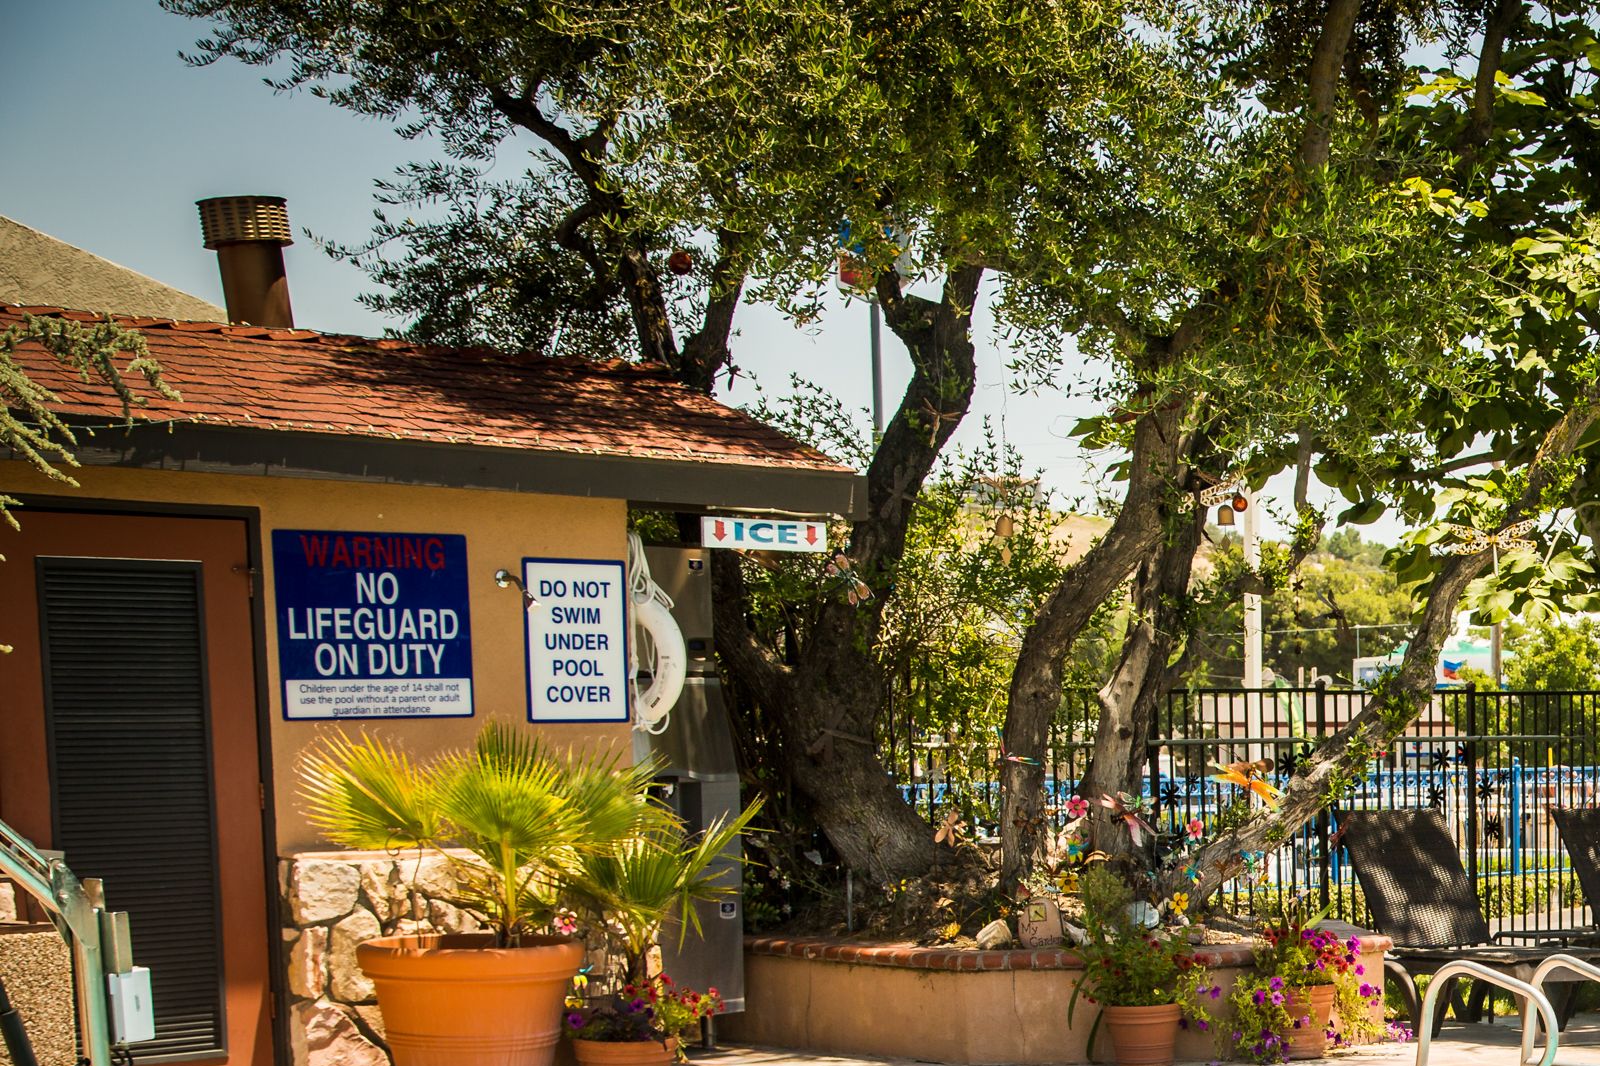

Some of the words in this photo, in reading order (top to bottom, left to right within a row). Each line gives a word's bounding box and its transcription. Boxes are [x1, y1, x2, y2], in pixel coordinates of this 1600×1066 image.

[734, 521, 798, 544] ICE
[301, 535, 446, 570] WARNING
[355, 571, 399, 605] NO
[540, 580, 567, 597] DO
[573, 581, 611, 598] NOT
[287, 607, 459, 641] LIFEGUARD
[551, 606, 601, 624] SWIM
[545, 633, 609, 650] UNDER
[314, 642, 359, 677] ON
[367, 643, 446, 676] DUTY
[552, 659, 604, 677] POOL
[299, 684, 337, 694] Children
[339, 683, 364, 693] under
[367, 683, 381, 692] the
[383, 685, 399, 694] age
[400, 682, 410, 692] of
[412, 683, 422, 692] 14
[424, 682, 443, 692] shall
[445, 683, 460, 692] not
[546, 685, 611, 703] COVER
[318, 695, 333, 704] the
[335, 694, 354, 705] pool
[356, 694, 389, 703] without
[391, 695, 397, 703] a
[399, 694, 426, 704] parent
[439, 693, 460, 702] adult
[332, 705, 371, 716] guardian
[373, 705, 381, 714] in
[383, 704, 431, 714] attendance
[1021, 922, 1039, 935] My
